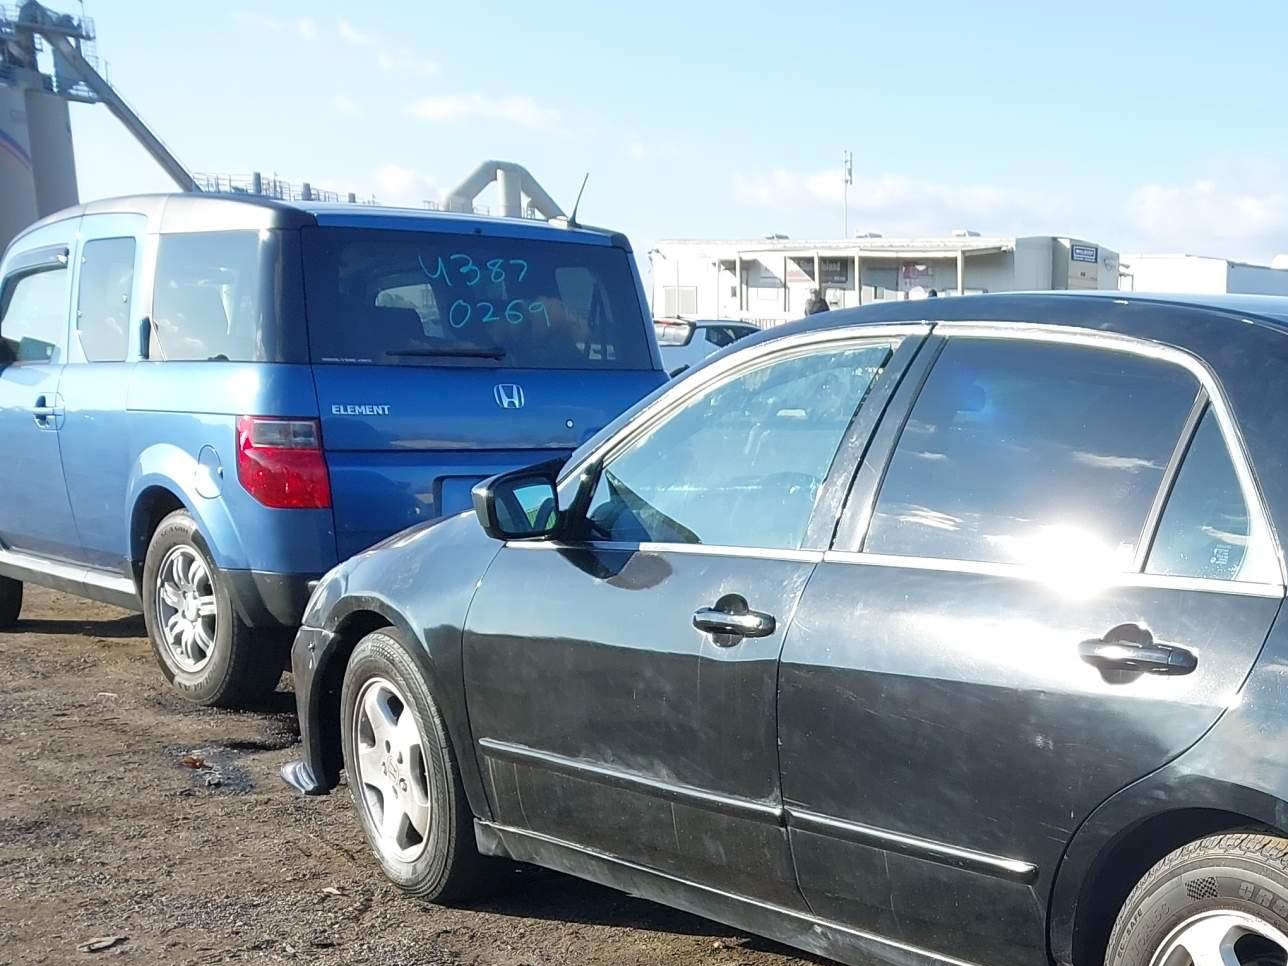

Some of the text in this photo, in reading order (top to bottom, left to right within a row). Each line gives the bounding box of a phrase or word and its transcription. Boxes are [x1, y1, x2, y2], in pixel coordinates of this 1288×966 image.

[418, 254, 528, 287] 4387
[449, 299, 550, 328] 0269
[331, 404, 391, 415] ELEMENT
[1126, 908, 1143, 936] SAFE
